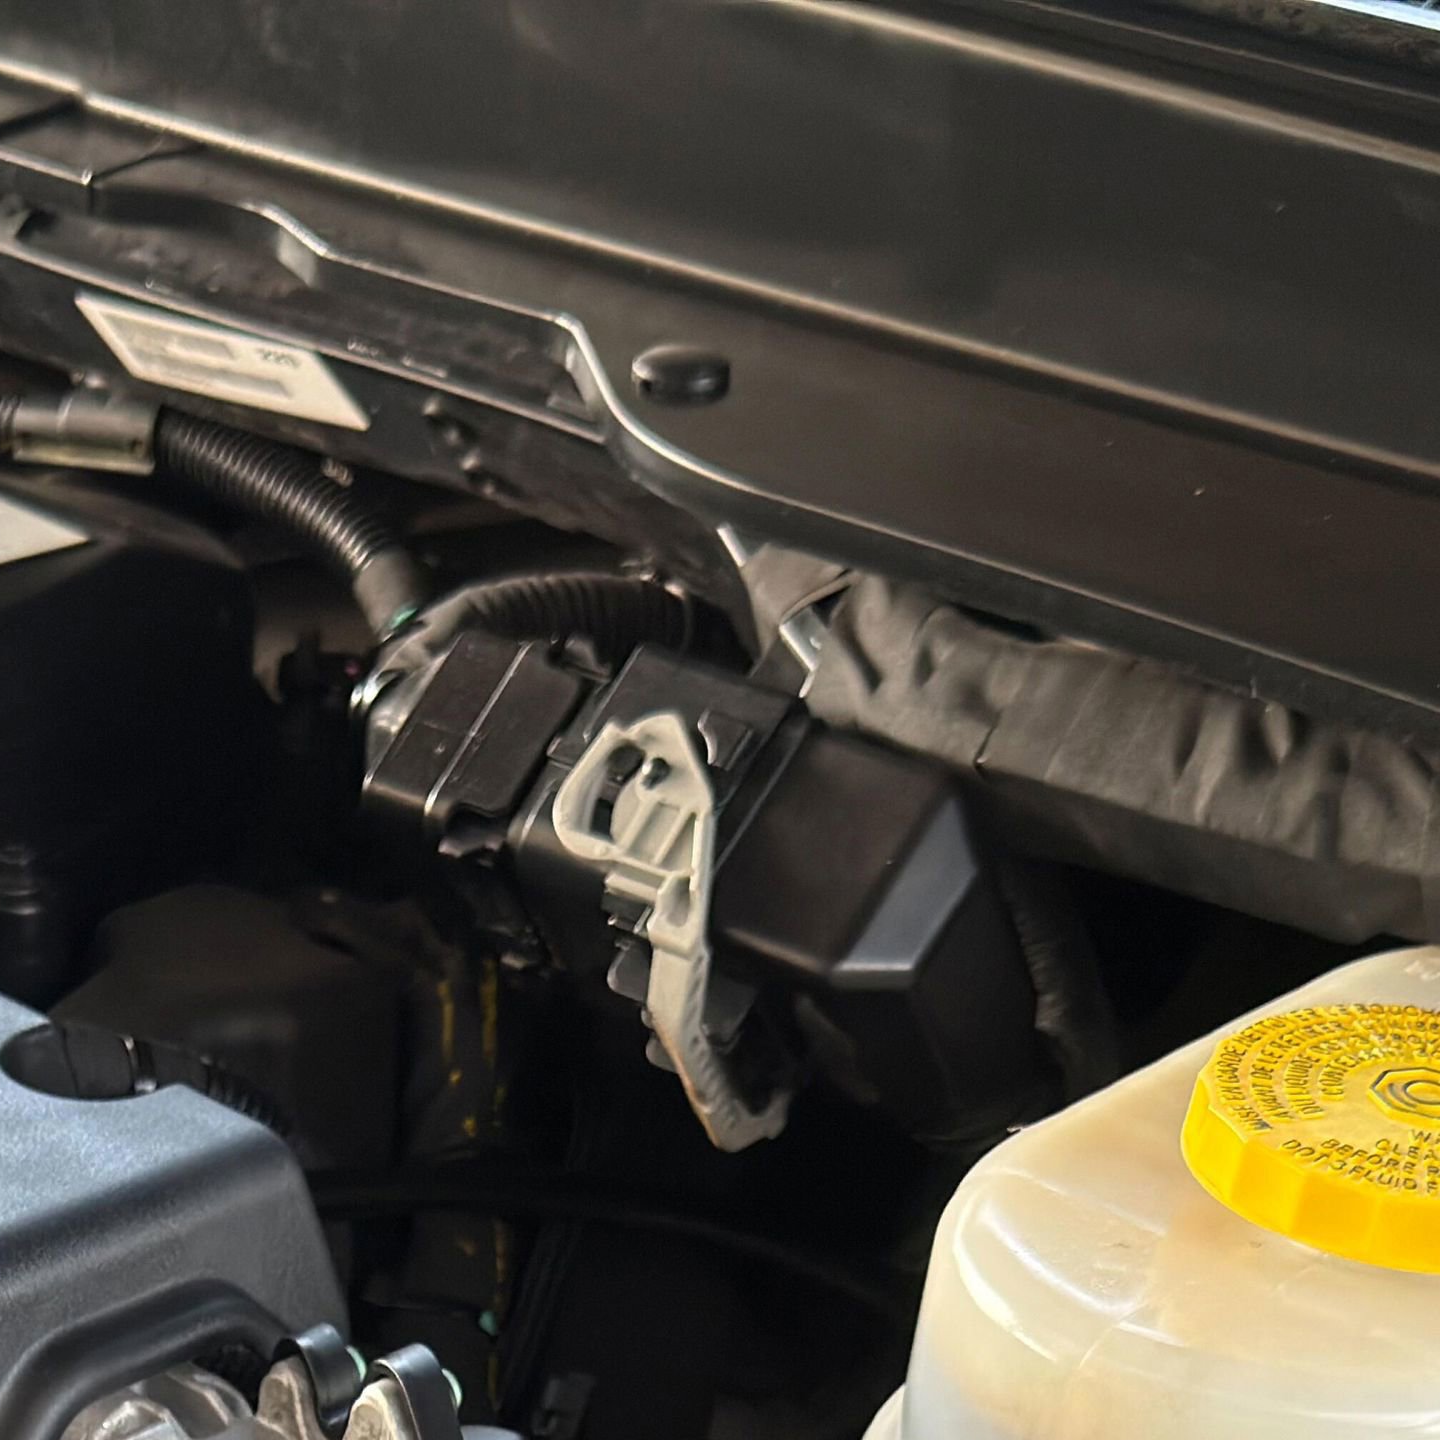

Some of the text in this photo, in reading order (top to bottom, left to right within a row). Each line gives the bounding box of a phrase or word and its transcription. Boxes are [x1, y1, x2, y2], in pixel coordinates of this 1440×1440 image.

[1216, 1045, 1247, 1084] GARDE
[1234, 1007, 1321, 1048] NETTOYER
[1280, 1138, 1330, 1163] DOT
[1347, 1164, 1419, 1192] FLUID
[1320, 1137, 1418, 1175] BEFORE
